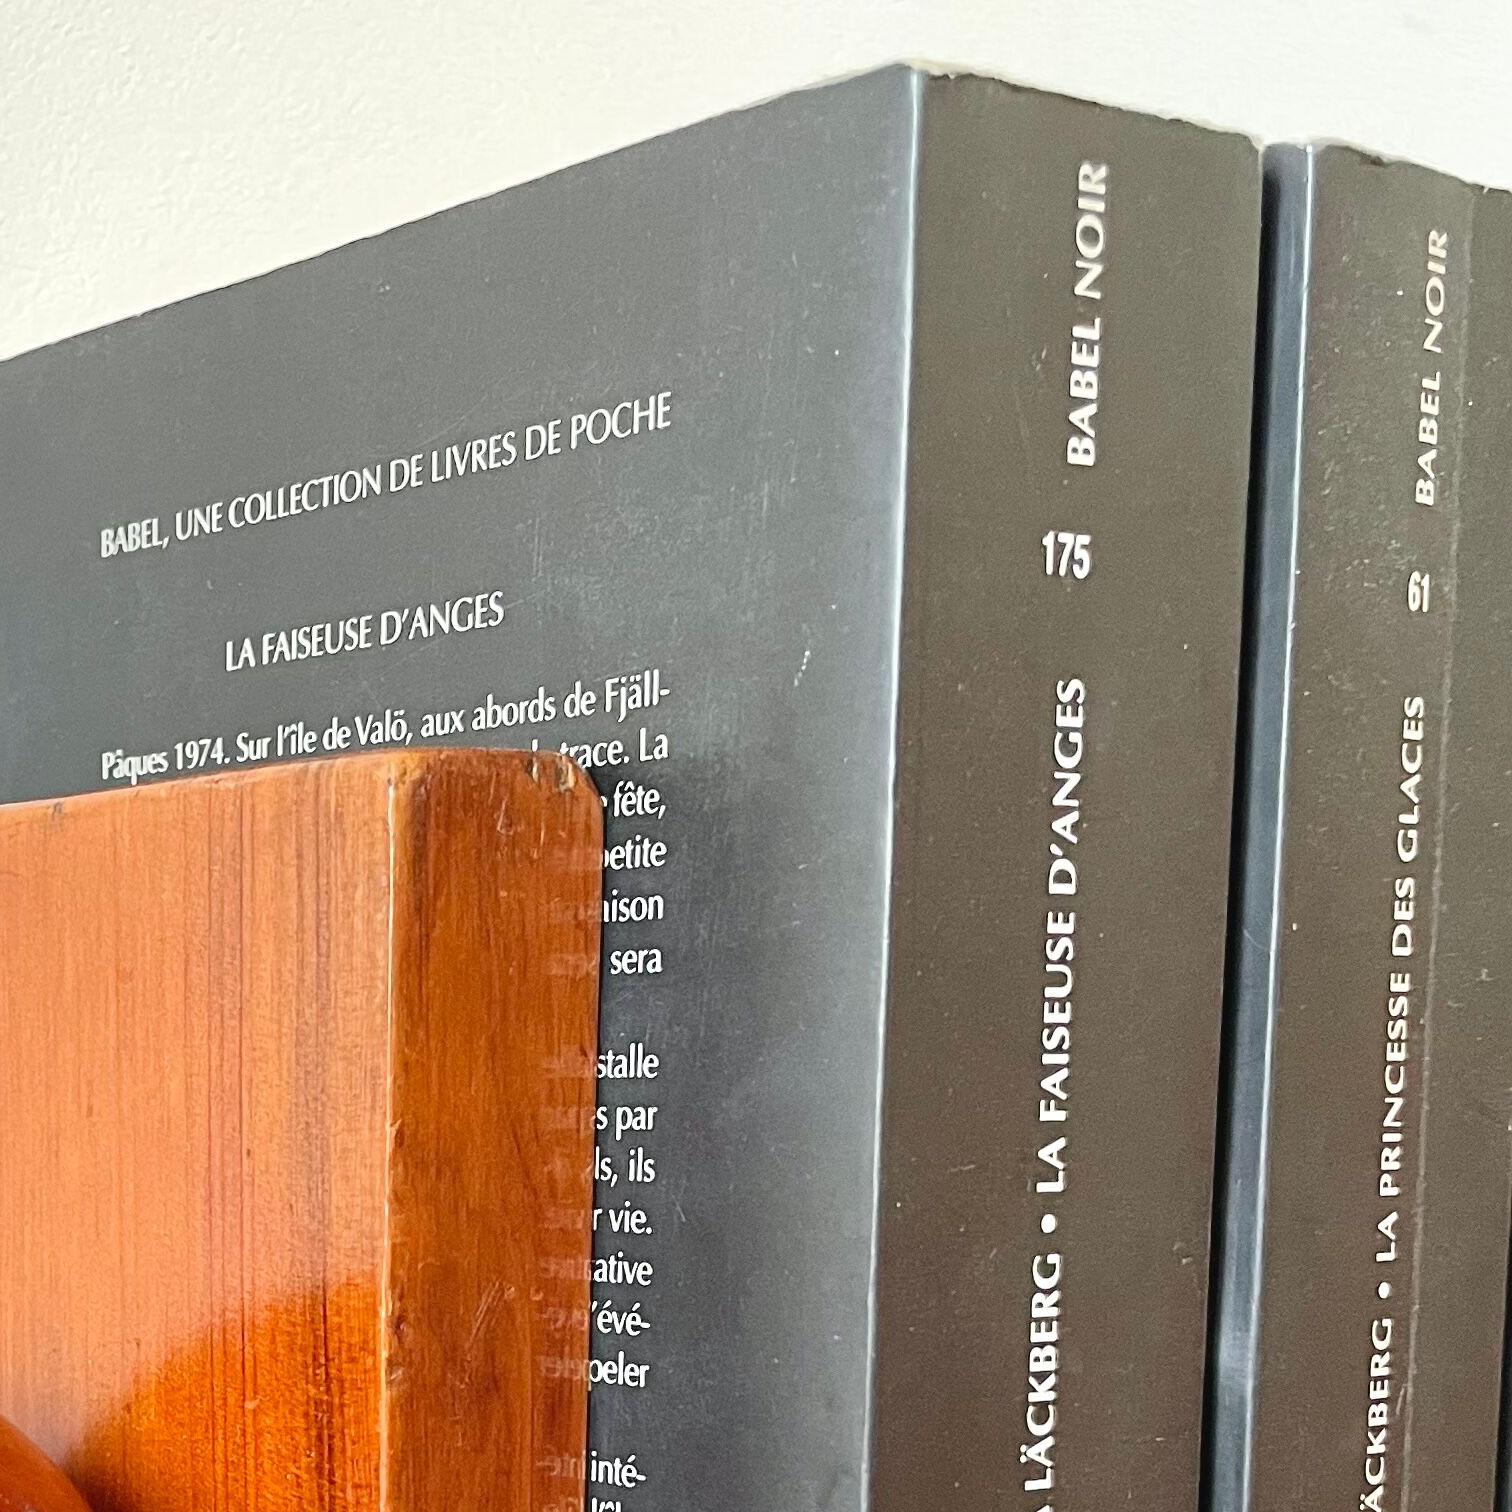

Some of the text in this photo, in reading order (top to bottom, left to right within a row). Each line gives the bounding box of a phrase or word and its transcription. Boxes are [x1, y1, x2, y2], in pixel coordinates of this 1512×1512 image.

[1066, 161, 1108, 467] BABEL NOIR
[1415, 229, 1448, 506] BABEL NOIR
[100, 391, 672, 558] BABEL, UNE COLLECTION DE LIVRES DE POCHE
[1042, 530, 1092, 580] 175
[1408, 570, 1430, 613] 61
[225, 590, 505, 672] LA FAISEUSE D'ANGES
[101, 668, 671, 786] Pâques 1974. Sur l'île de Valö, aux abords de Fjäll-
[639, 727, 669, 762] La
[613, 780, 666, 820] fête,
[1048, 678, 1086, 895] D'ANGES
[1397, 696, 1425, 863] GLACES
[1391, 877, 1415, 957] DES
[610, 948, 663, 975] sera
[1039, 911, 1076, 1122] FAISEUSE
[1379, 972, 1411, 1197] PRINCESSE
[615, 1106, 658, 1141] par
[628, 1146, 656, 1183] ils
[1036, 1136, 1066, 1193] LA
[608, 1200, 653, 1235] vie.
[1375, 1211, 1399, 1262] LA
[1019, 1253, 1062, 1491] LÄCKBERG
[590, 1450, 647, 1488] inté-
